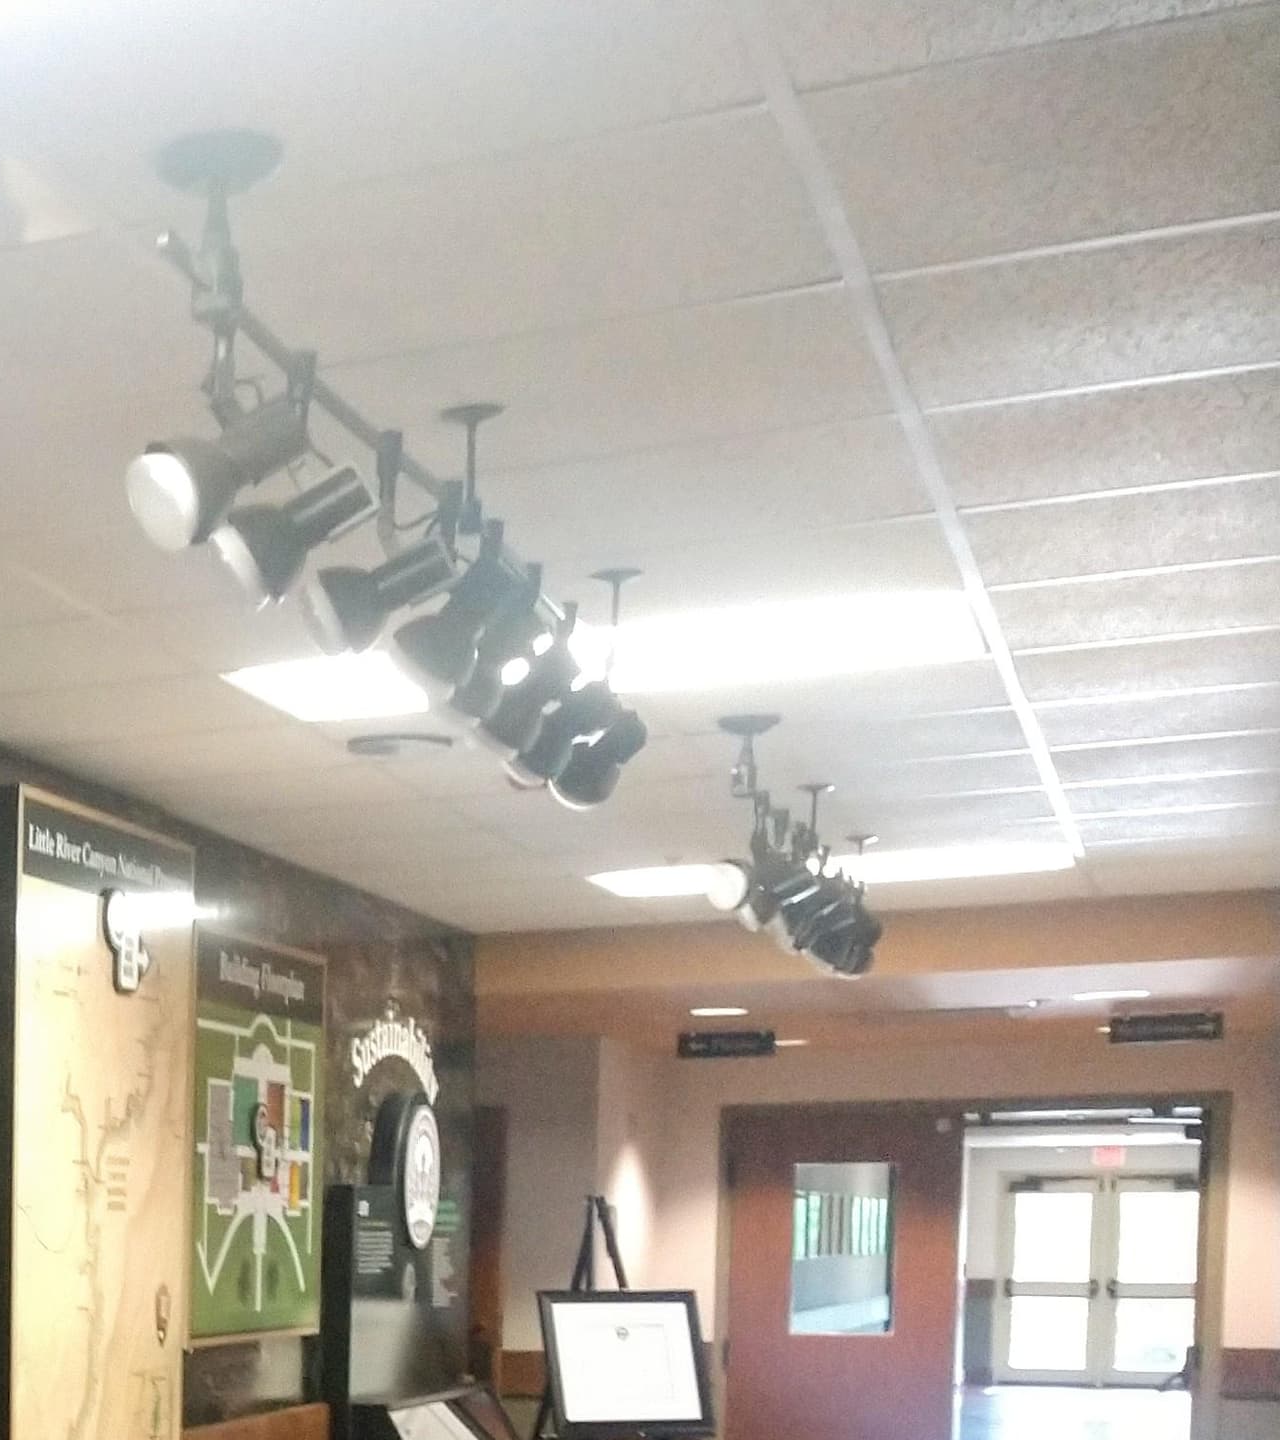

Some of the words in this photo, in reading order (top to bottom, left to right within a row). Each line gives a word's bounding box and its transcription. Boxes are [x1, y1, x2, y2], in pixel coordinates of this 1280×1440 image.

[28, 822, 55, 857] Little
[55, 831, 81, 864] River
[82, 842, 117, 878] Canyon
